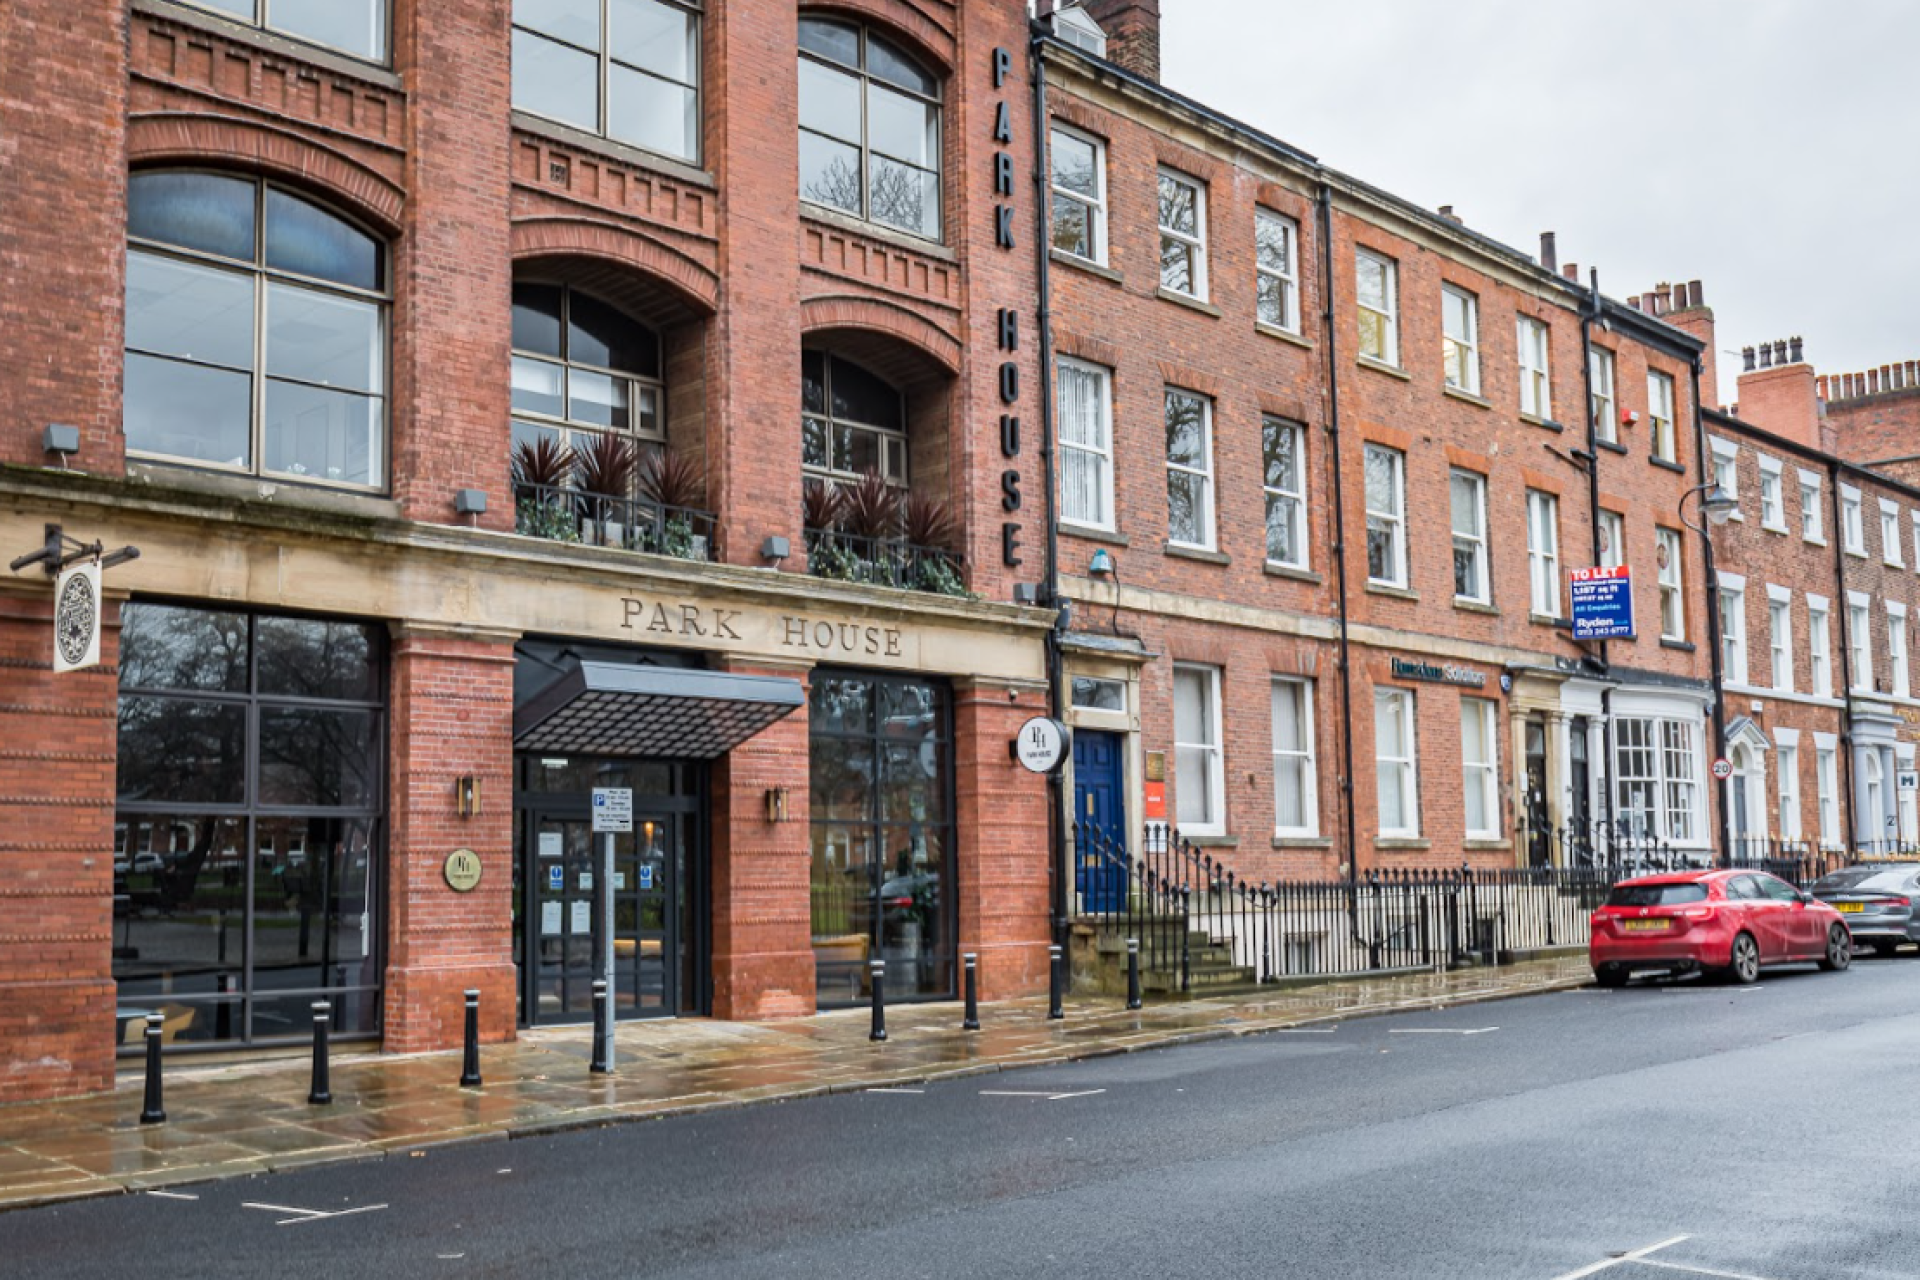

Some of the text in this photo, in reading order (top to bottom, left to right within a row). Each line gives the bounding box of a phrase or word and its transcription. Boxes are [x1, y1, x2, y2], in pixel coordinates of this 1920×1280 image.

[993, 47, 1022, 567] PARK HOUSE
[1572, 567, 1617, 580] TO LET
[620, 597, 902, 656] PARK HOUSE
[1577, 617, 1614, 628] Ryden
[1713, 764, 1729, 772] 20
[597, 796, 604, 806] P
